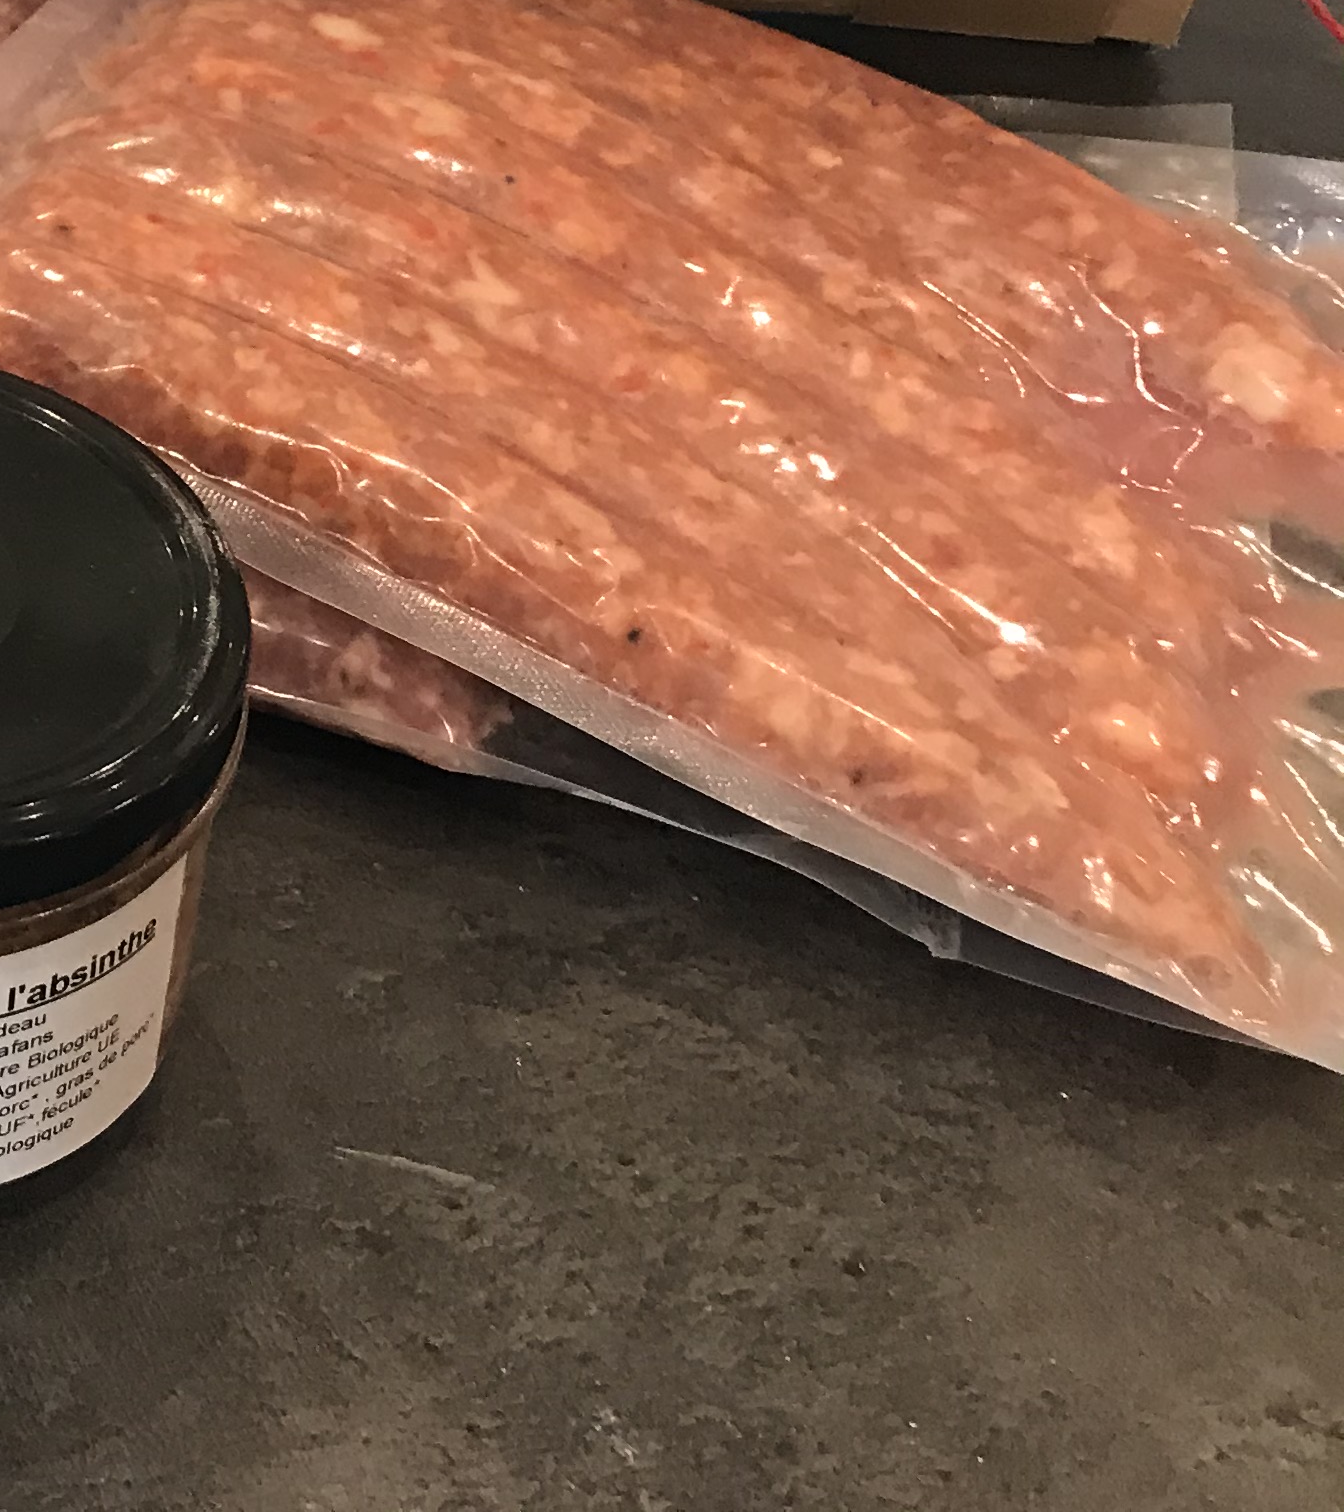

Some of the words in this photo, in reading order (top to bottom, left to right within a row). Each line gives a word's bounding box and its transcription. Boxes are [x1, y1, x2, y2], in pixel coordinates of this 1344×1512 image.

[7, 917, 157, 1012] l'absinthe
[27, 1013, 119, 1069] Biologique
[98, 1028, 119, 1053] UE
[55, 1068, 94, 1097] gras
[98, 1051, 117, 1071] de
